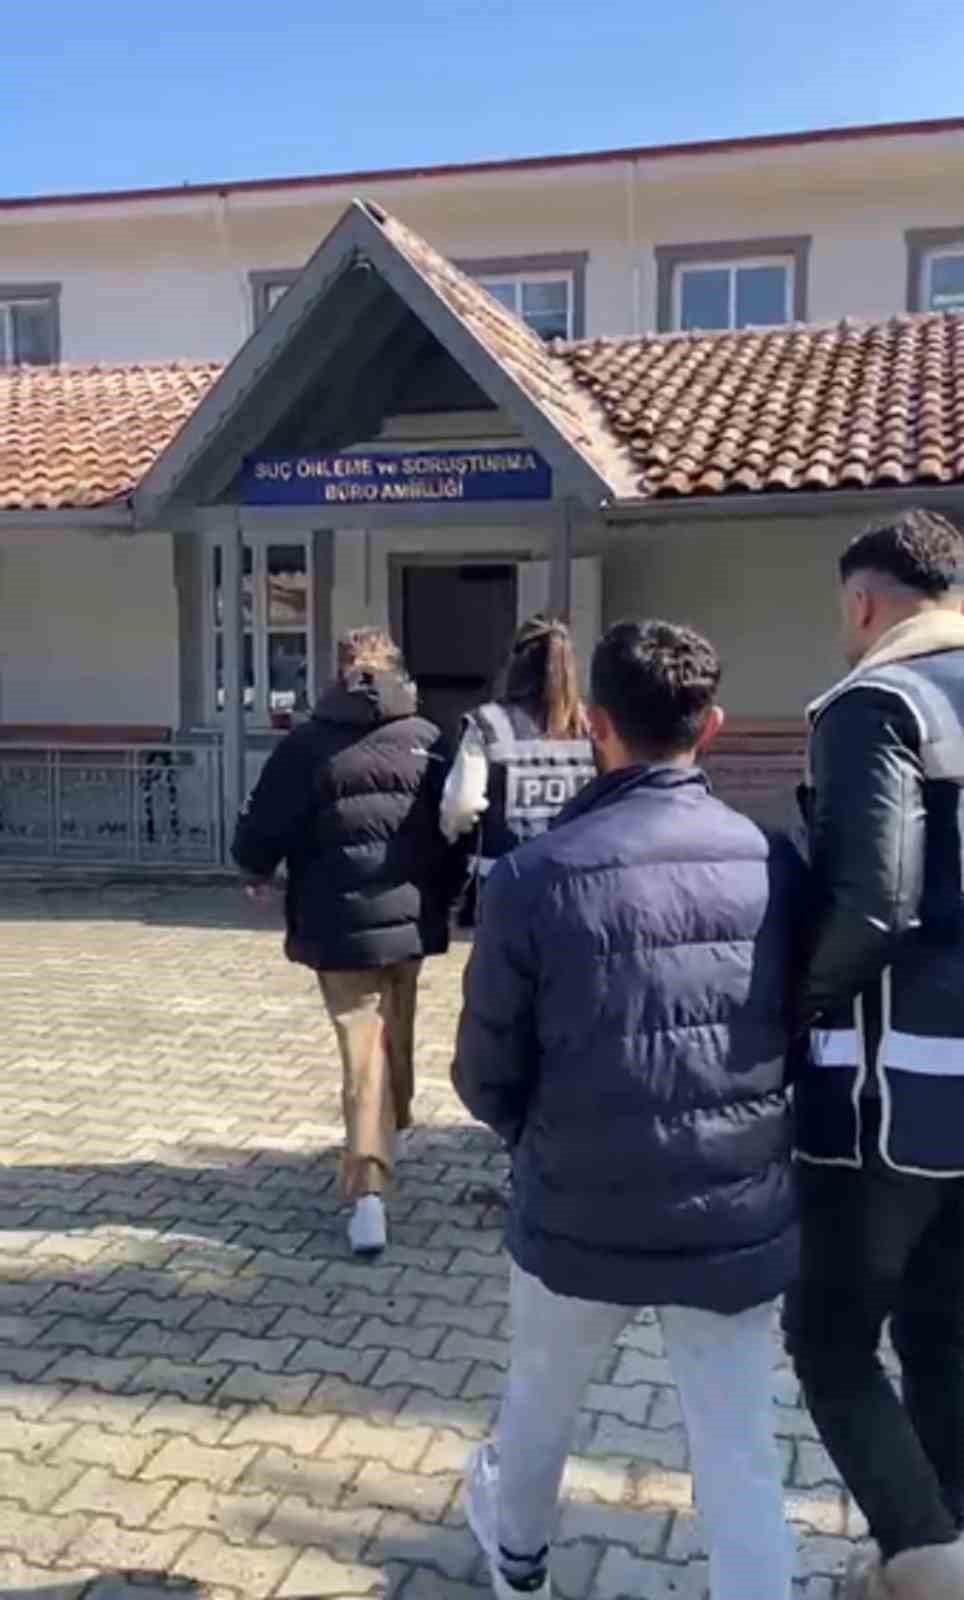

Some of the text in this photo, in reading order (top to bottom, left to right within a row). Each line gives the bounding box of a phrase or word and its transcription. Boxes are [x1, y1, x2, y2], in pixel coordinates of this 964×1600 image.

[254, 453, 537, 480] SUÇ ÖNLEME ve SORUŞTURMA
[325, 481, 378, 501] BÜRO
